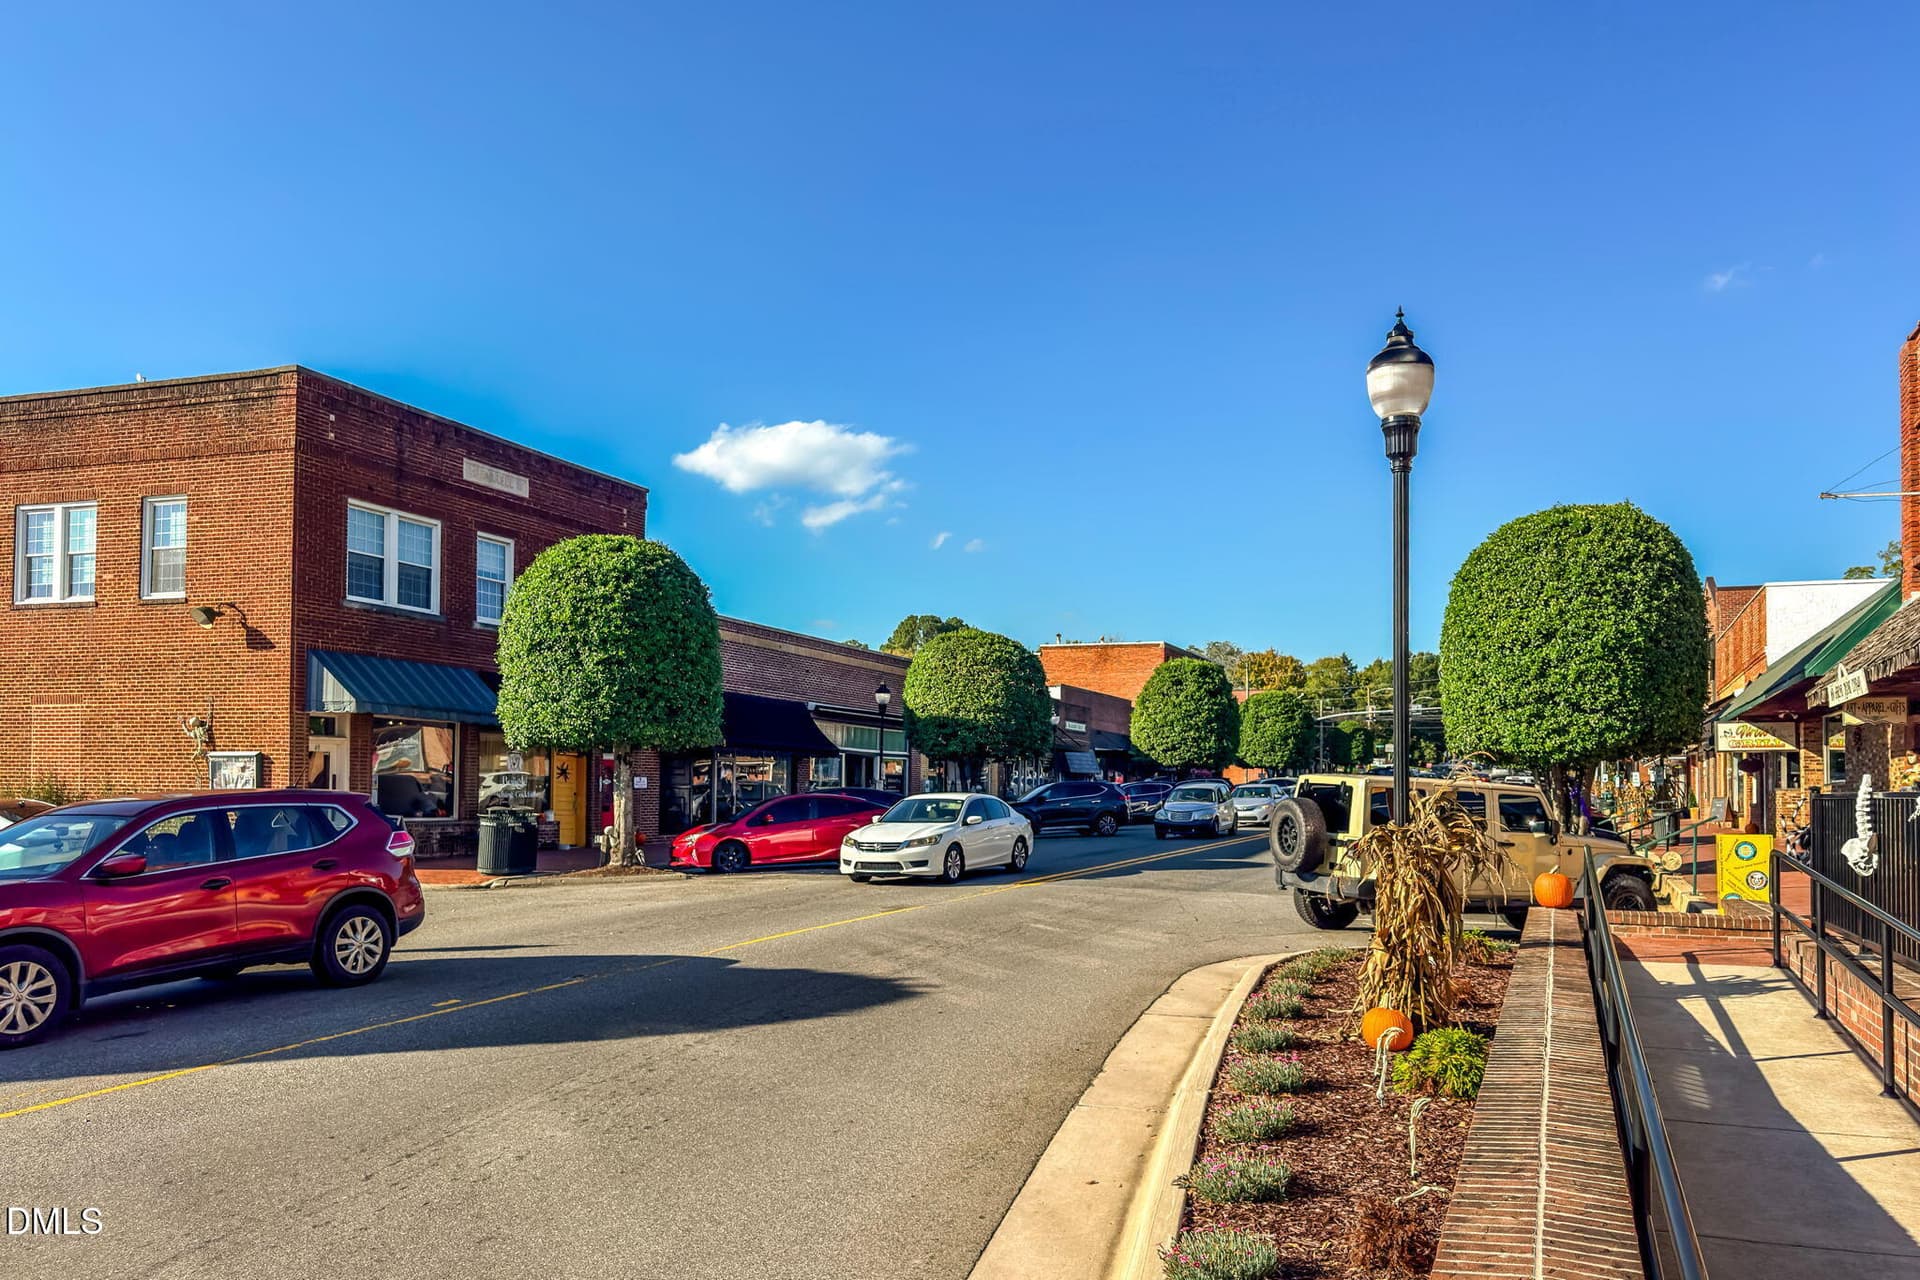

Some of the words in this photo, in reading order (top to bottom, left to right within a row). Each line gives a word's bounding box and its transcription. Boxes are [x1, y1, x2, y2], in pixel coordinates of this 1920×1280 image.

[1861, 701, 1888, 715] APPAREL
[1889, 699, 1906, 716] GIFTS
[1728, 739, 1786, 749] GRILL
